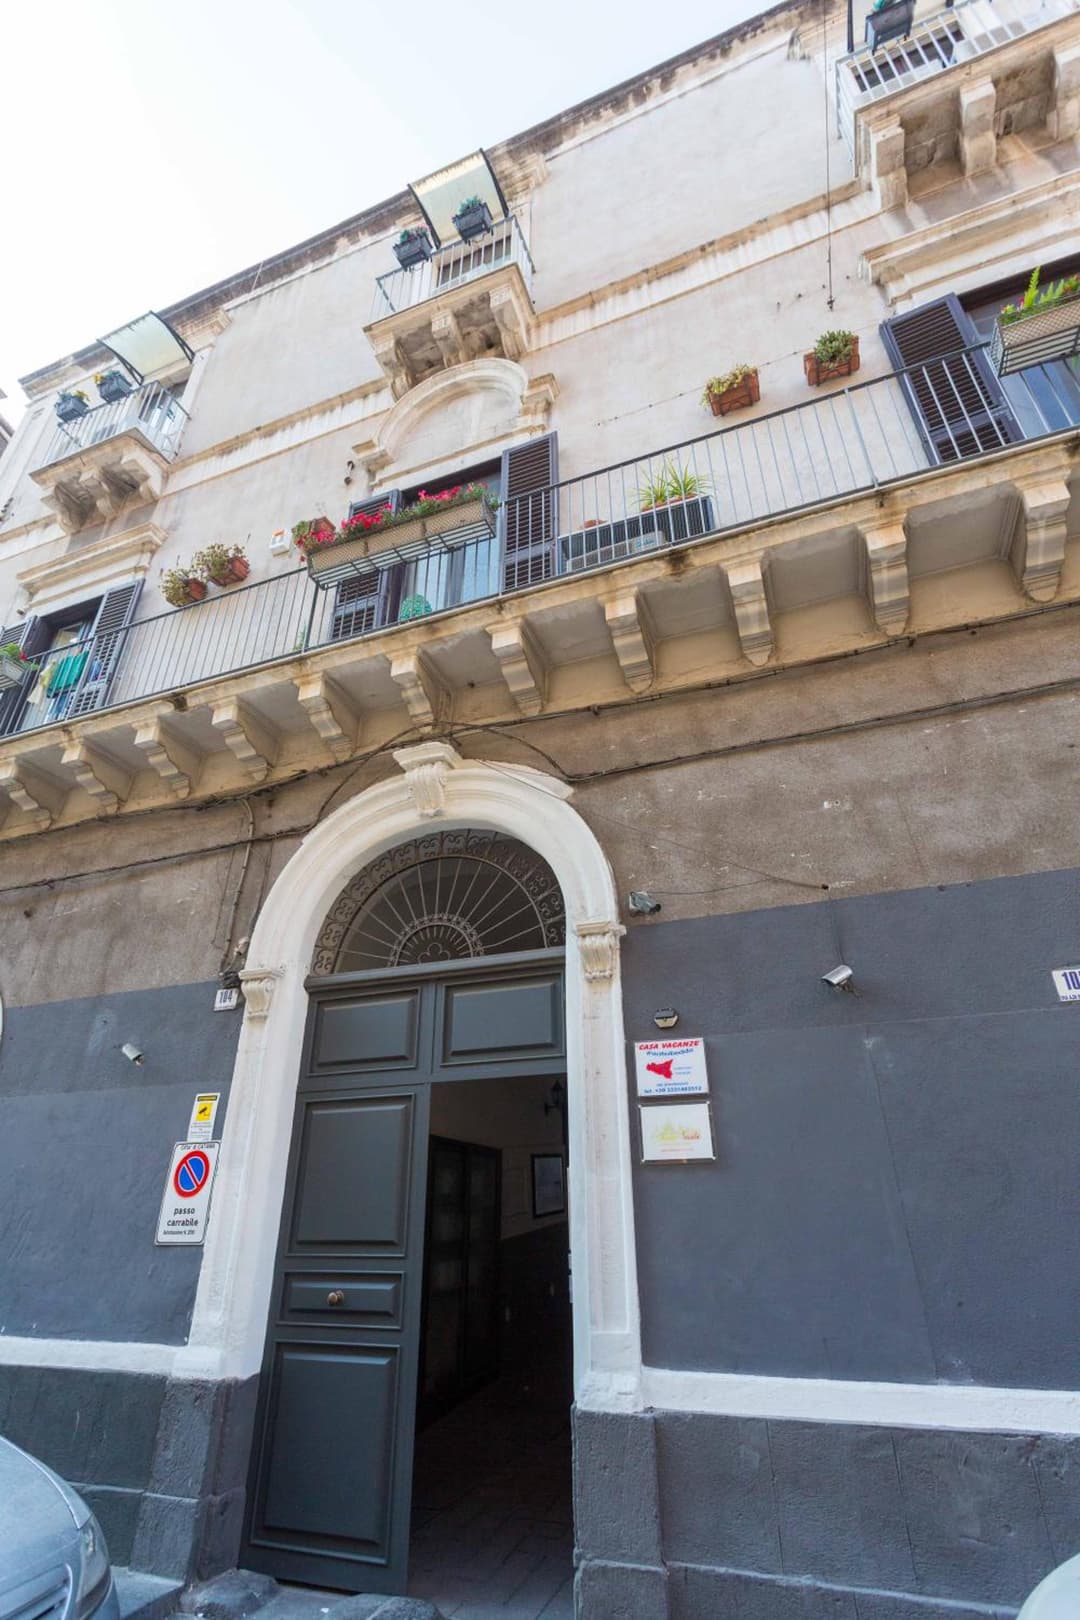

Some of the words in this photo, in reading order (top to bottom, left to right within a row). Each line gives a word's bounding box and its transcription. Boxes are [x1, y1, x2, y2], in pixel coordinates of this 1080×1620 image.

[1061, 971, 1080, 990] 10
[219, 990, 233, 1003] 104
[639, 1043, 659, 1051] CASA
[662, 1040, 700, 1049] VACANZE
[173, 1207, 196, 1216] passo
[166, 1218, 199, 1227] carrabile
